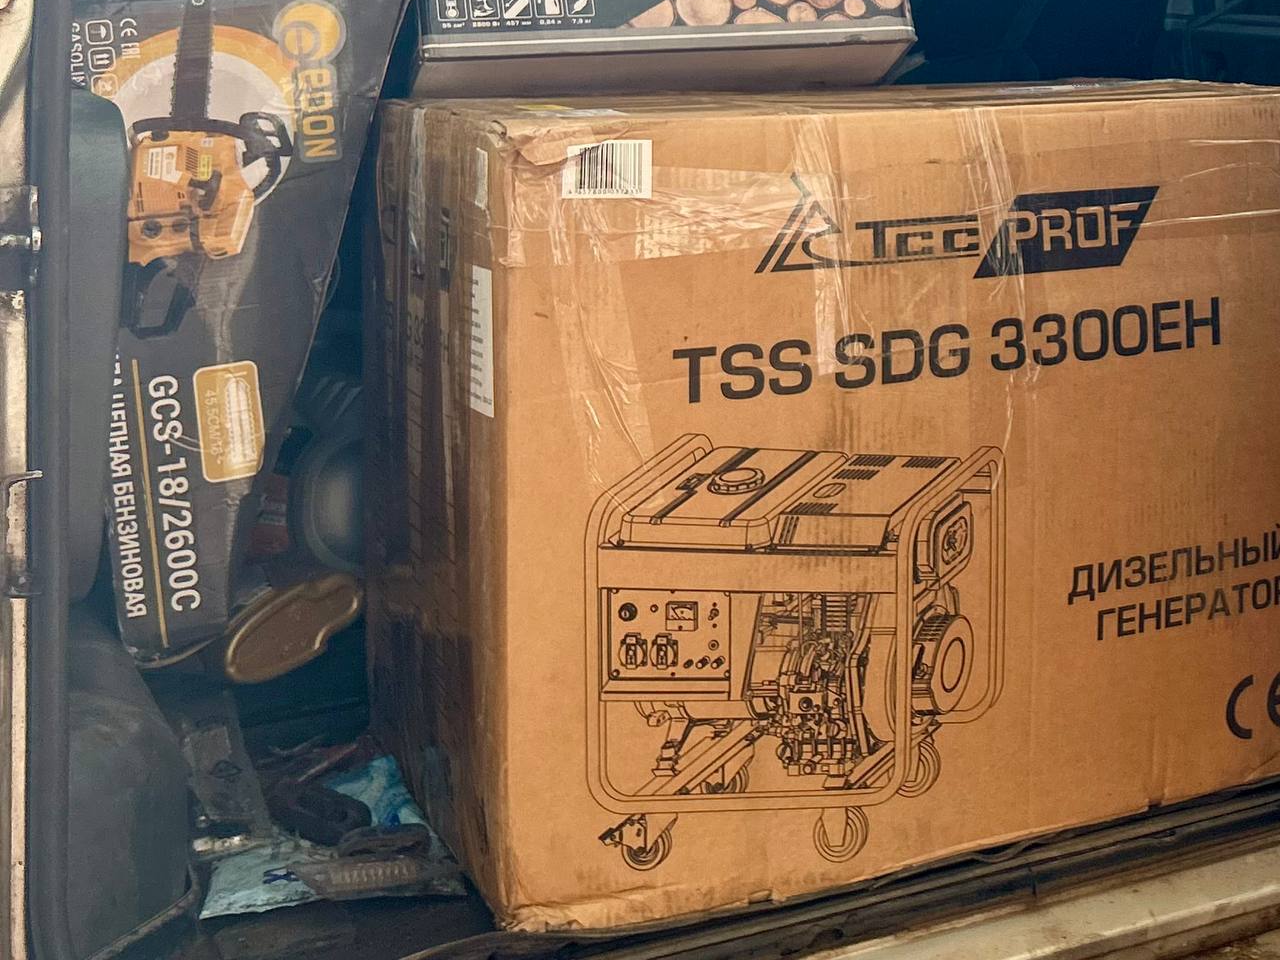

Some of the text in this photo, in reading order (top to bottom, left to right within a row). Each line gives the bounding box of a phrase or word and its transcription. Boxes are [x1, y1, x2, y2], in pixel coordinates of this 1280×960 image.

[70, 22, 86, 86] GASOLIN
[1007, 202, 1141, 254] PROF
[673, 295, 1222, 404] TSS SDG 3300EH
[148, 374, 201, 612] GCS-18/2600C
[113, 481, 148, 619] БЕНЗИНОВАЯ
